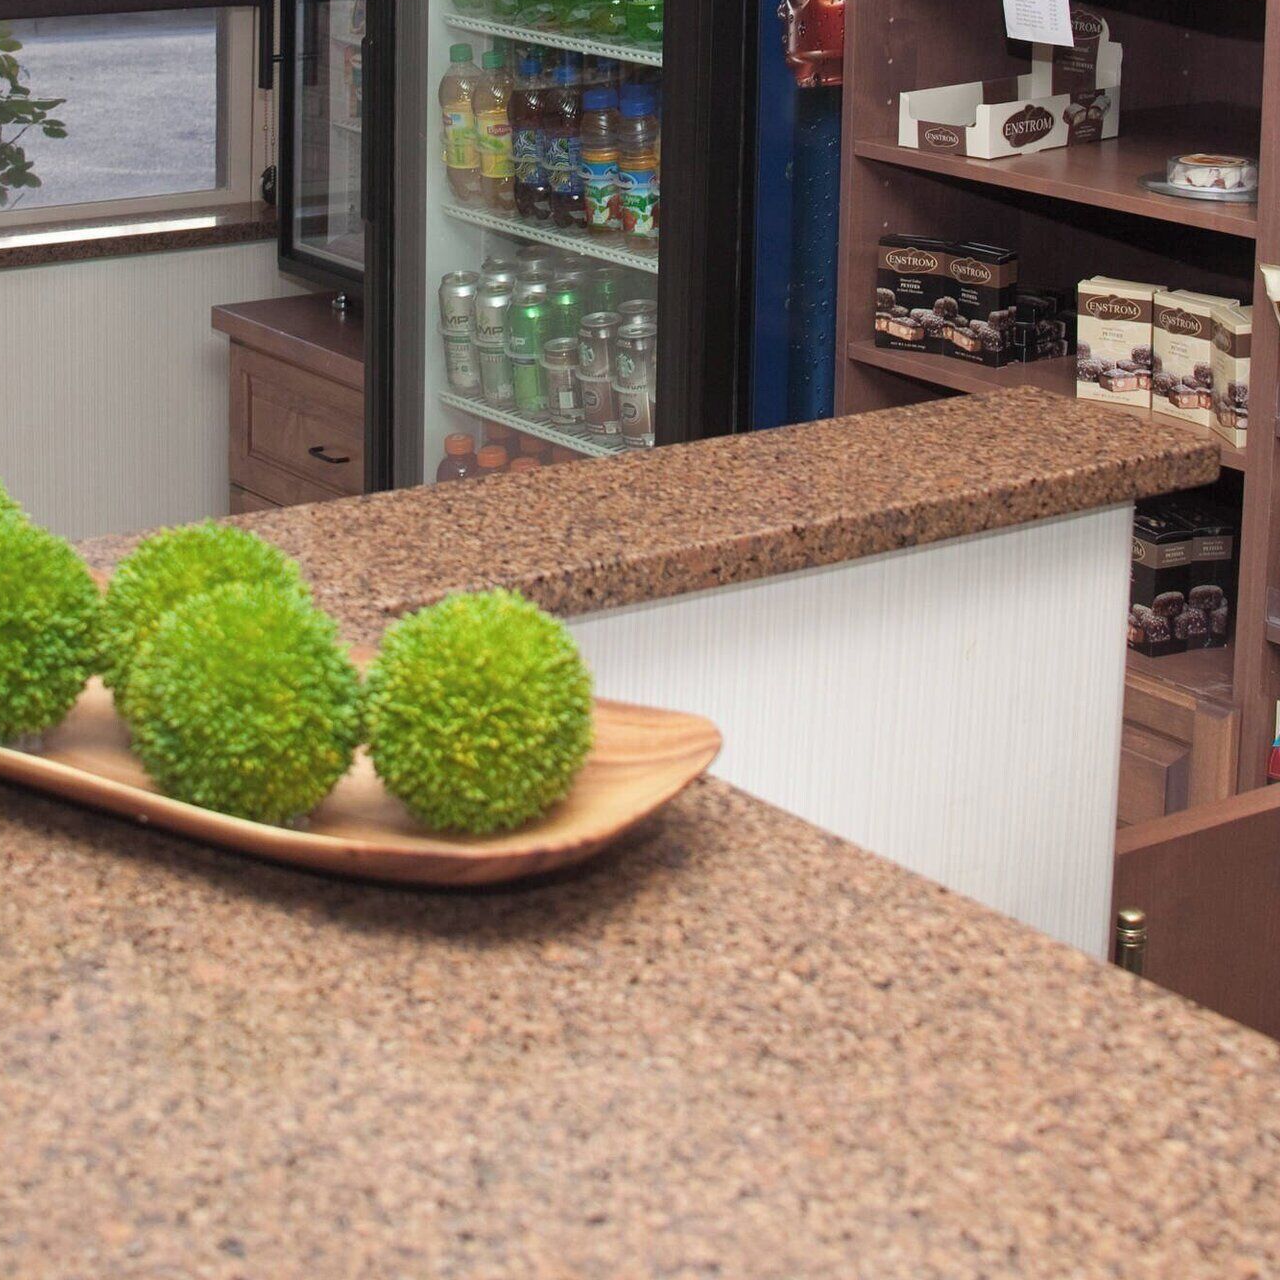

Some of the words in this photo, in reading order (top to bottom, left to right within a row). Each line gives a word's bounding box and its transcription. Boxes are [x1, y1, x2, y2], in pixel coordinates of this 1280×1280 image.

[1005, 117, 1052, 136] ENSTROM
[927, 133, 957, 143] ENSTROM
[889, 254, 934, 268] ENSTROM
[952, 265, 988, 279] ENSTROM
[1089, 301, 1137, 315] ENSTROM
[1161, 315, 1199, 331] ENSTROM
